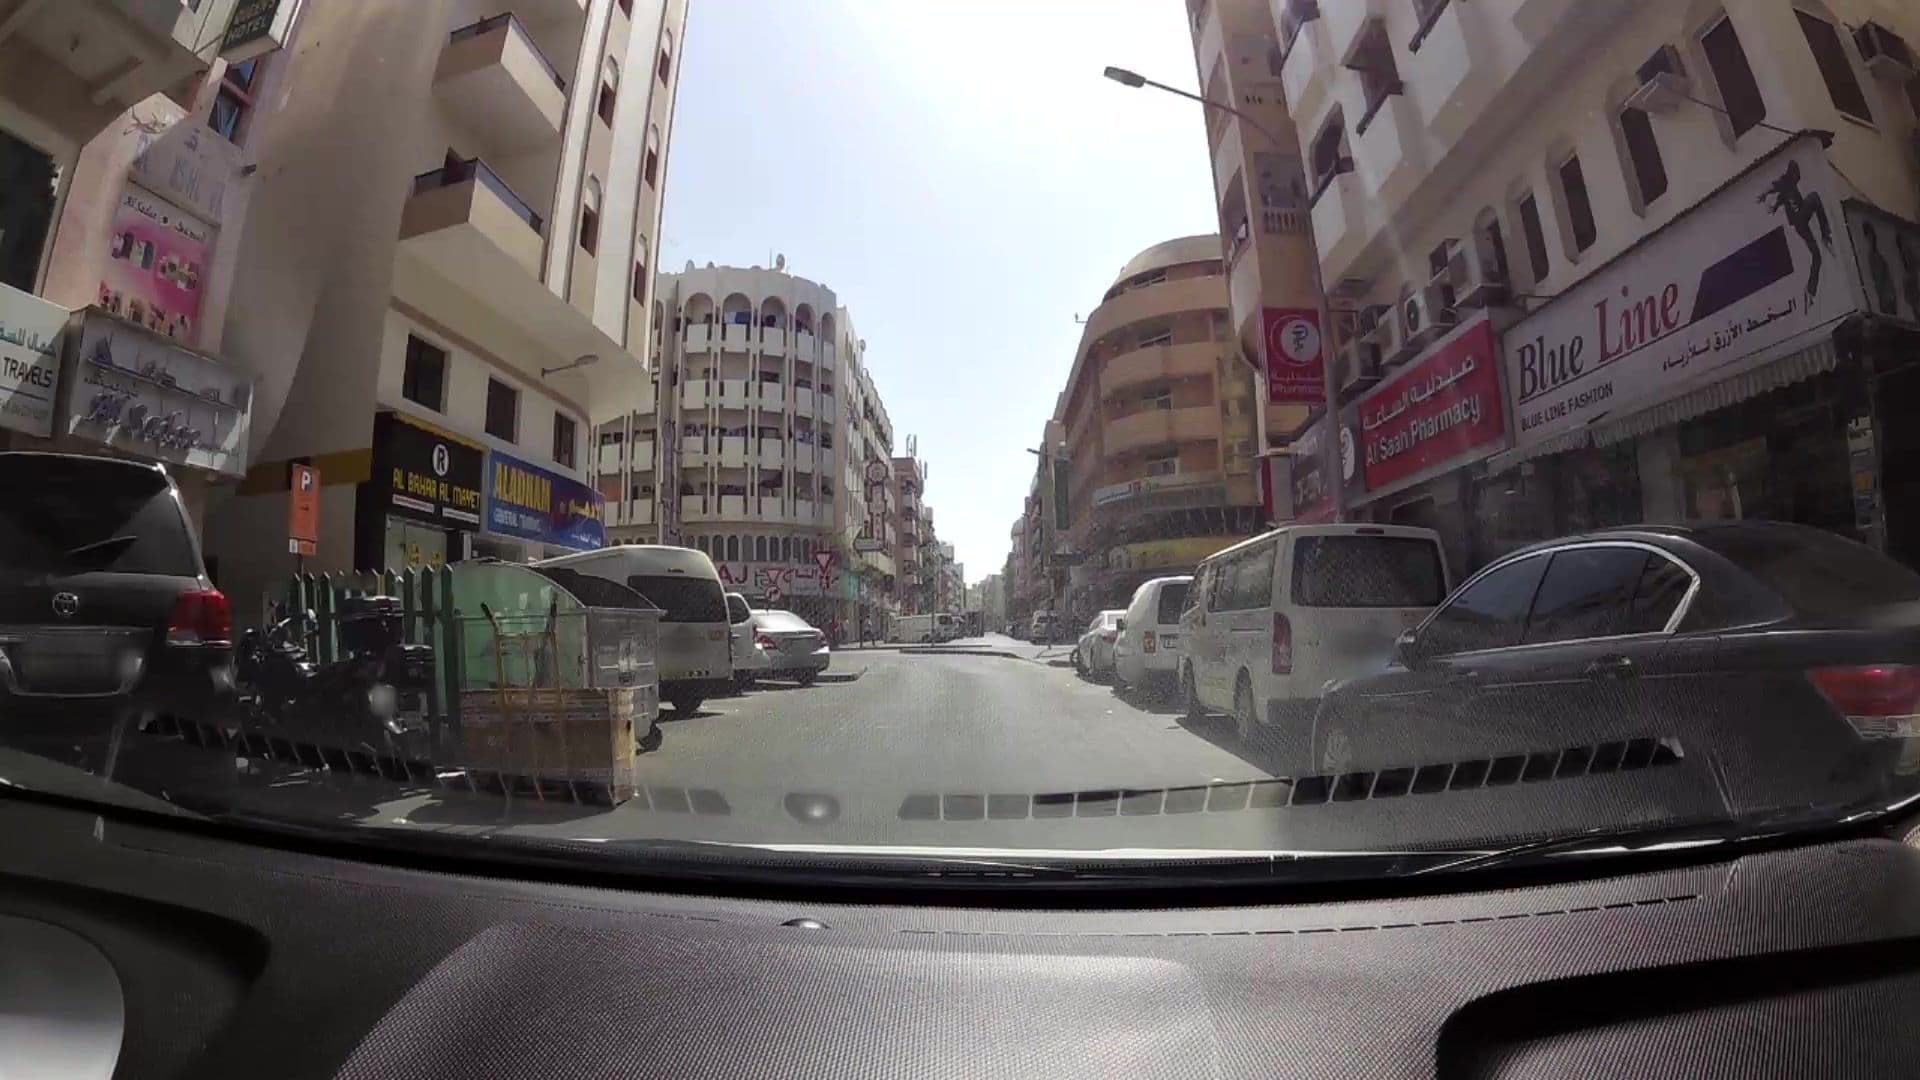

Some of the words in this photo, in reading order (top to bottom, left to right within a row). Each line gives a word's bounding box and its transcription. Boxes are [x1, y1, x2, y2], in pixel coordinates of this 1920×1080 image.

[1516, 335, 1584, 400] Blue
[1594, 283, 1681, 363] Line
[4, 357, 53, 388] TRAVELS
[1521, 411, 1543, 432] BLUE
[1544, 401, 1567, 422] LINE
[1568, 381, 1613, 412] FASHION
[1366, 442, 1378, 466] Al
[1410, 393, 1480, 447] Pharmacy
[301, 471, 311, 491] P
[392, 467, 406, 490] AL
[407, 472, 438, 499] BAHAR
[439, 482, 450, 503] AL
